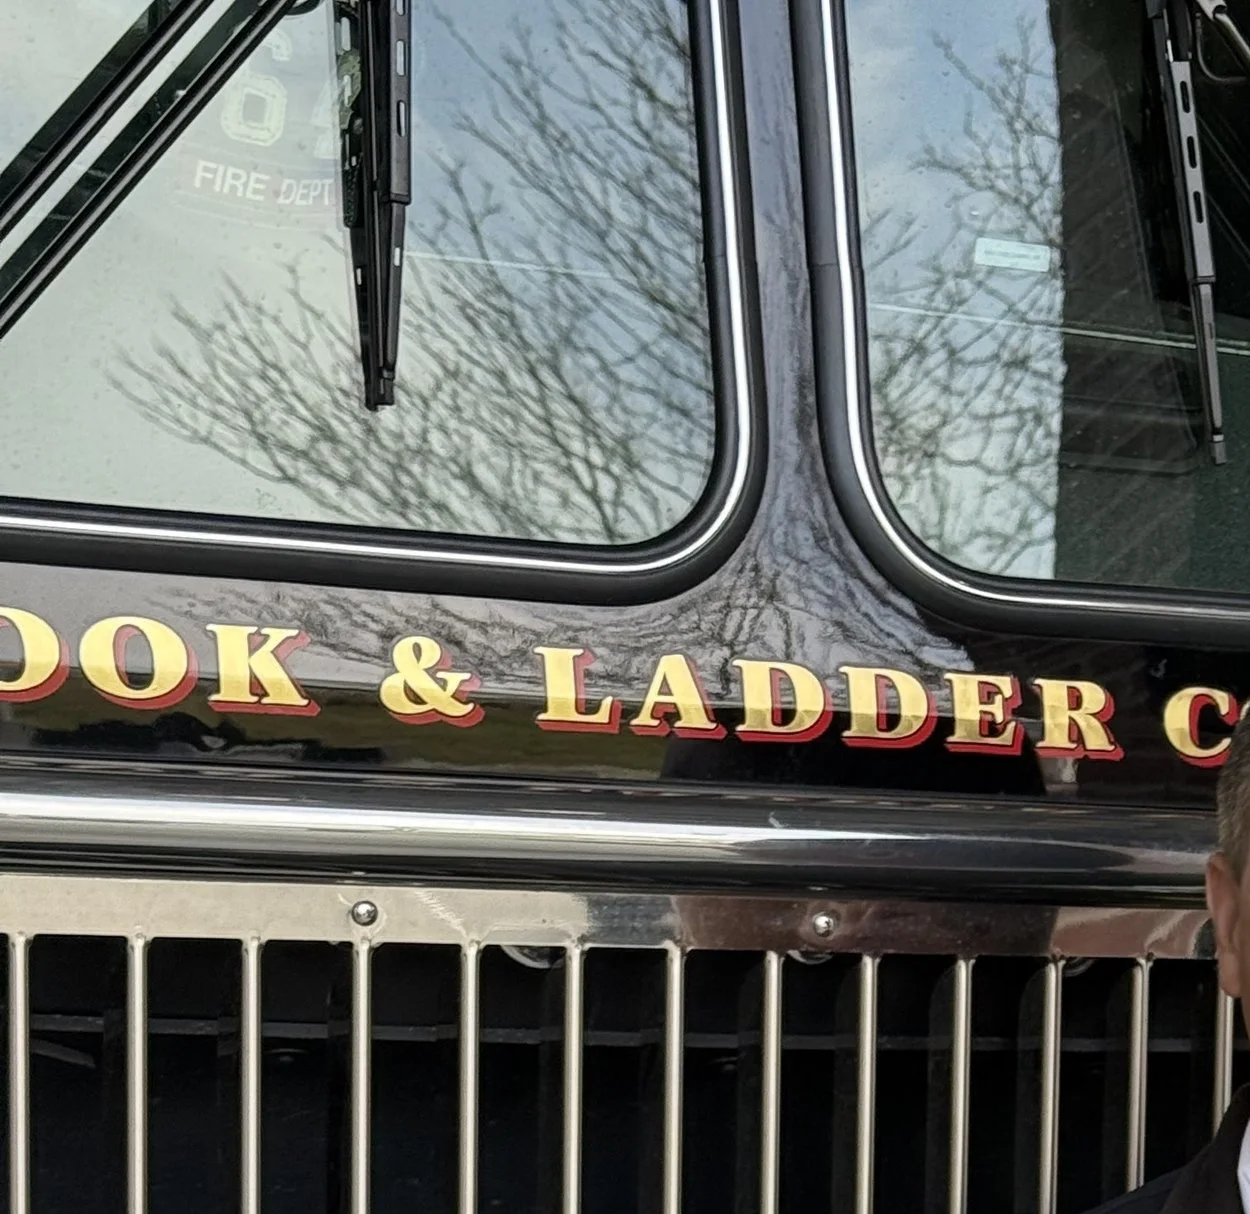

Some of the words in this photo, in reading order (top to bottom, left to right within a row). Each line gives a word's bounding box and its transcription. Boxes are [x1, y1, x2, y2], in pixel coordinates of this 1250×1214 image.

[193, 159, 271, 201] FIRE
[379, 635, 480, 722] &
[534, 646, 1120, 757] LADDER
